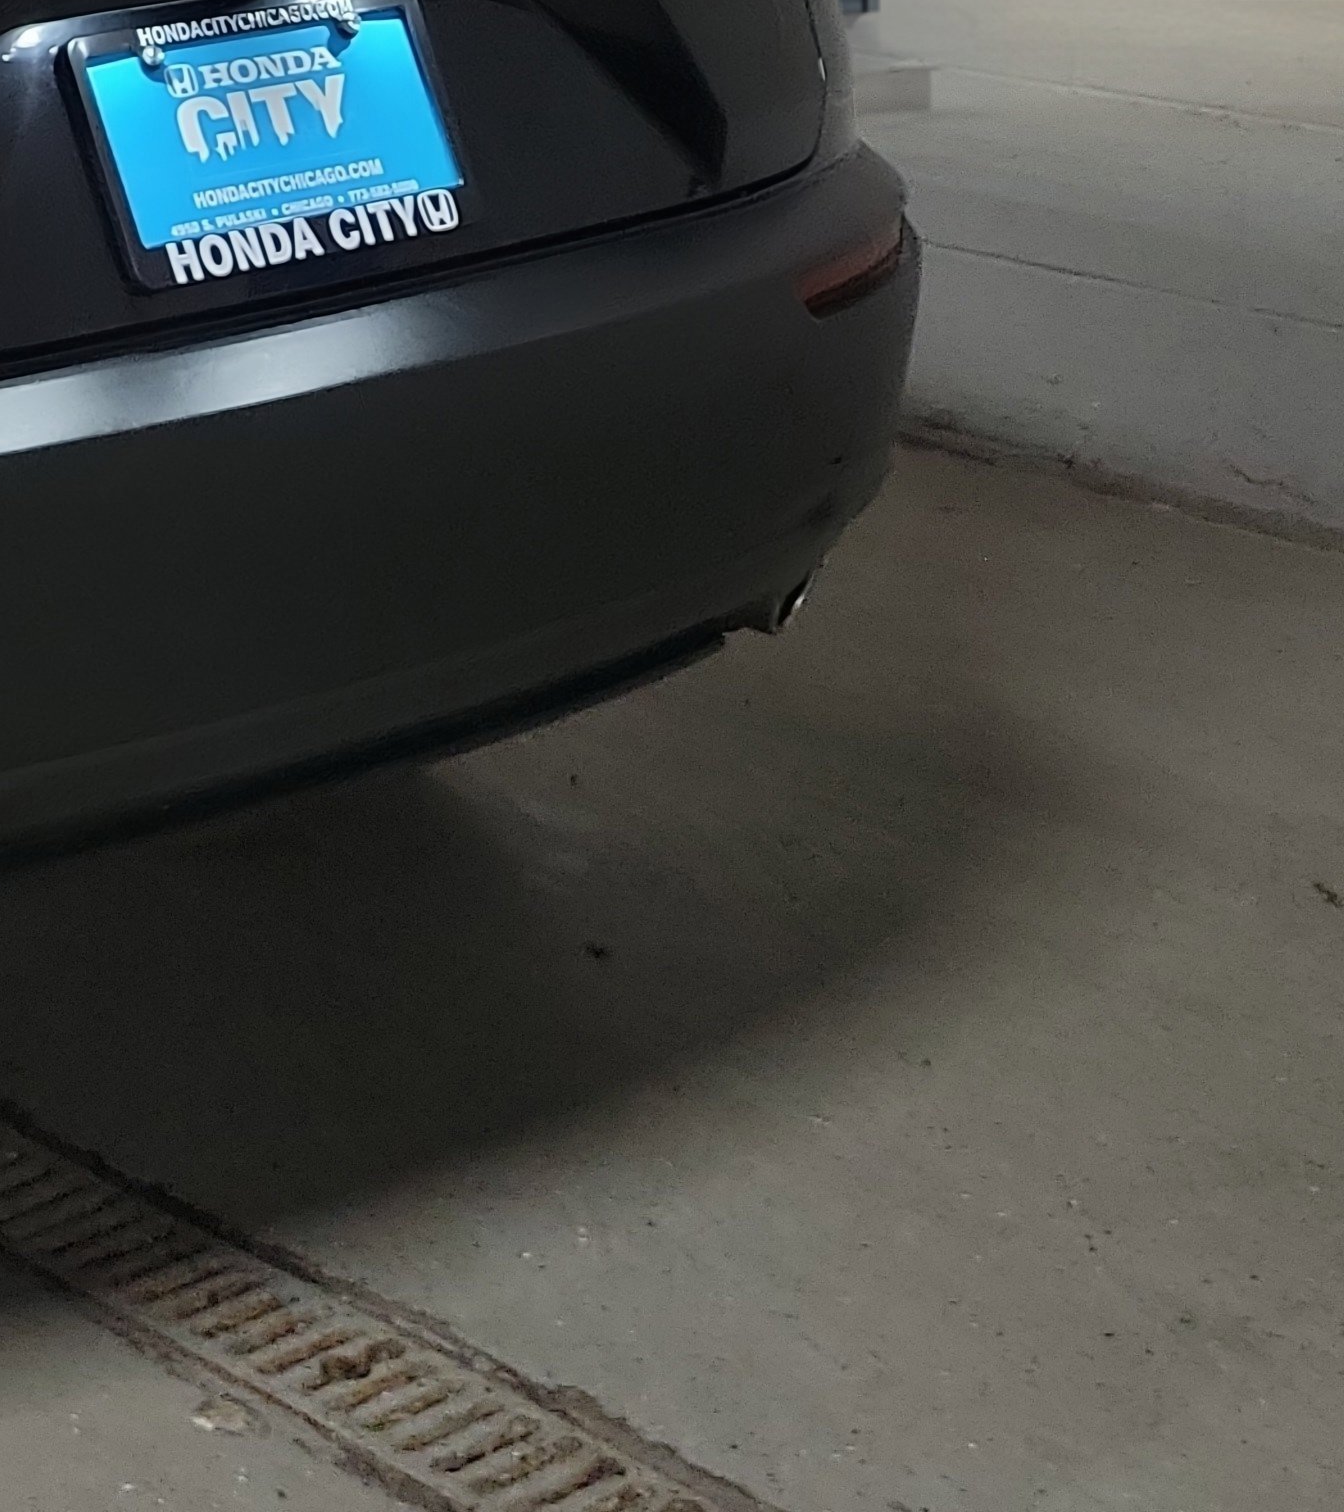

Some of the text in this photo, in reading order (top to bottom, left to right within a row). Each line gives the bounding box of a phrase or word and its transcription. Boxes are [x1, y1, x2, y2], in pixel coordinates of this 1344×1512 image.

[197, 46, 342, 89] HONDA
[176, 74, 345, 163] CITY
[192, 158, 385, 210] HONDACITYCHICAGO.COM
[165, 218, 325, 285] HONDA
[328, 191, 418, 252] CITY
